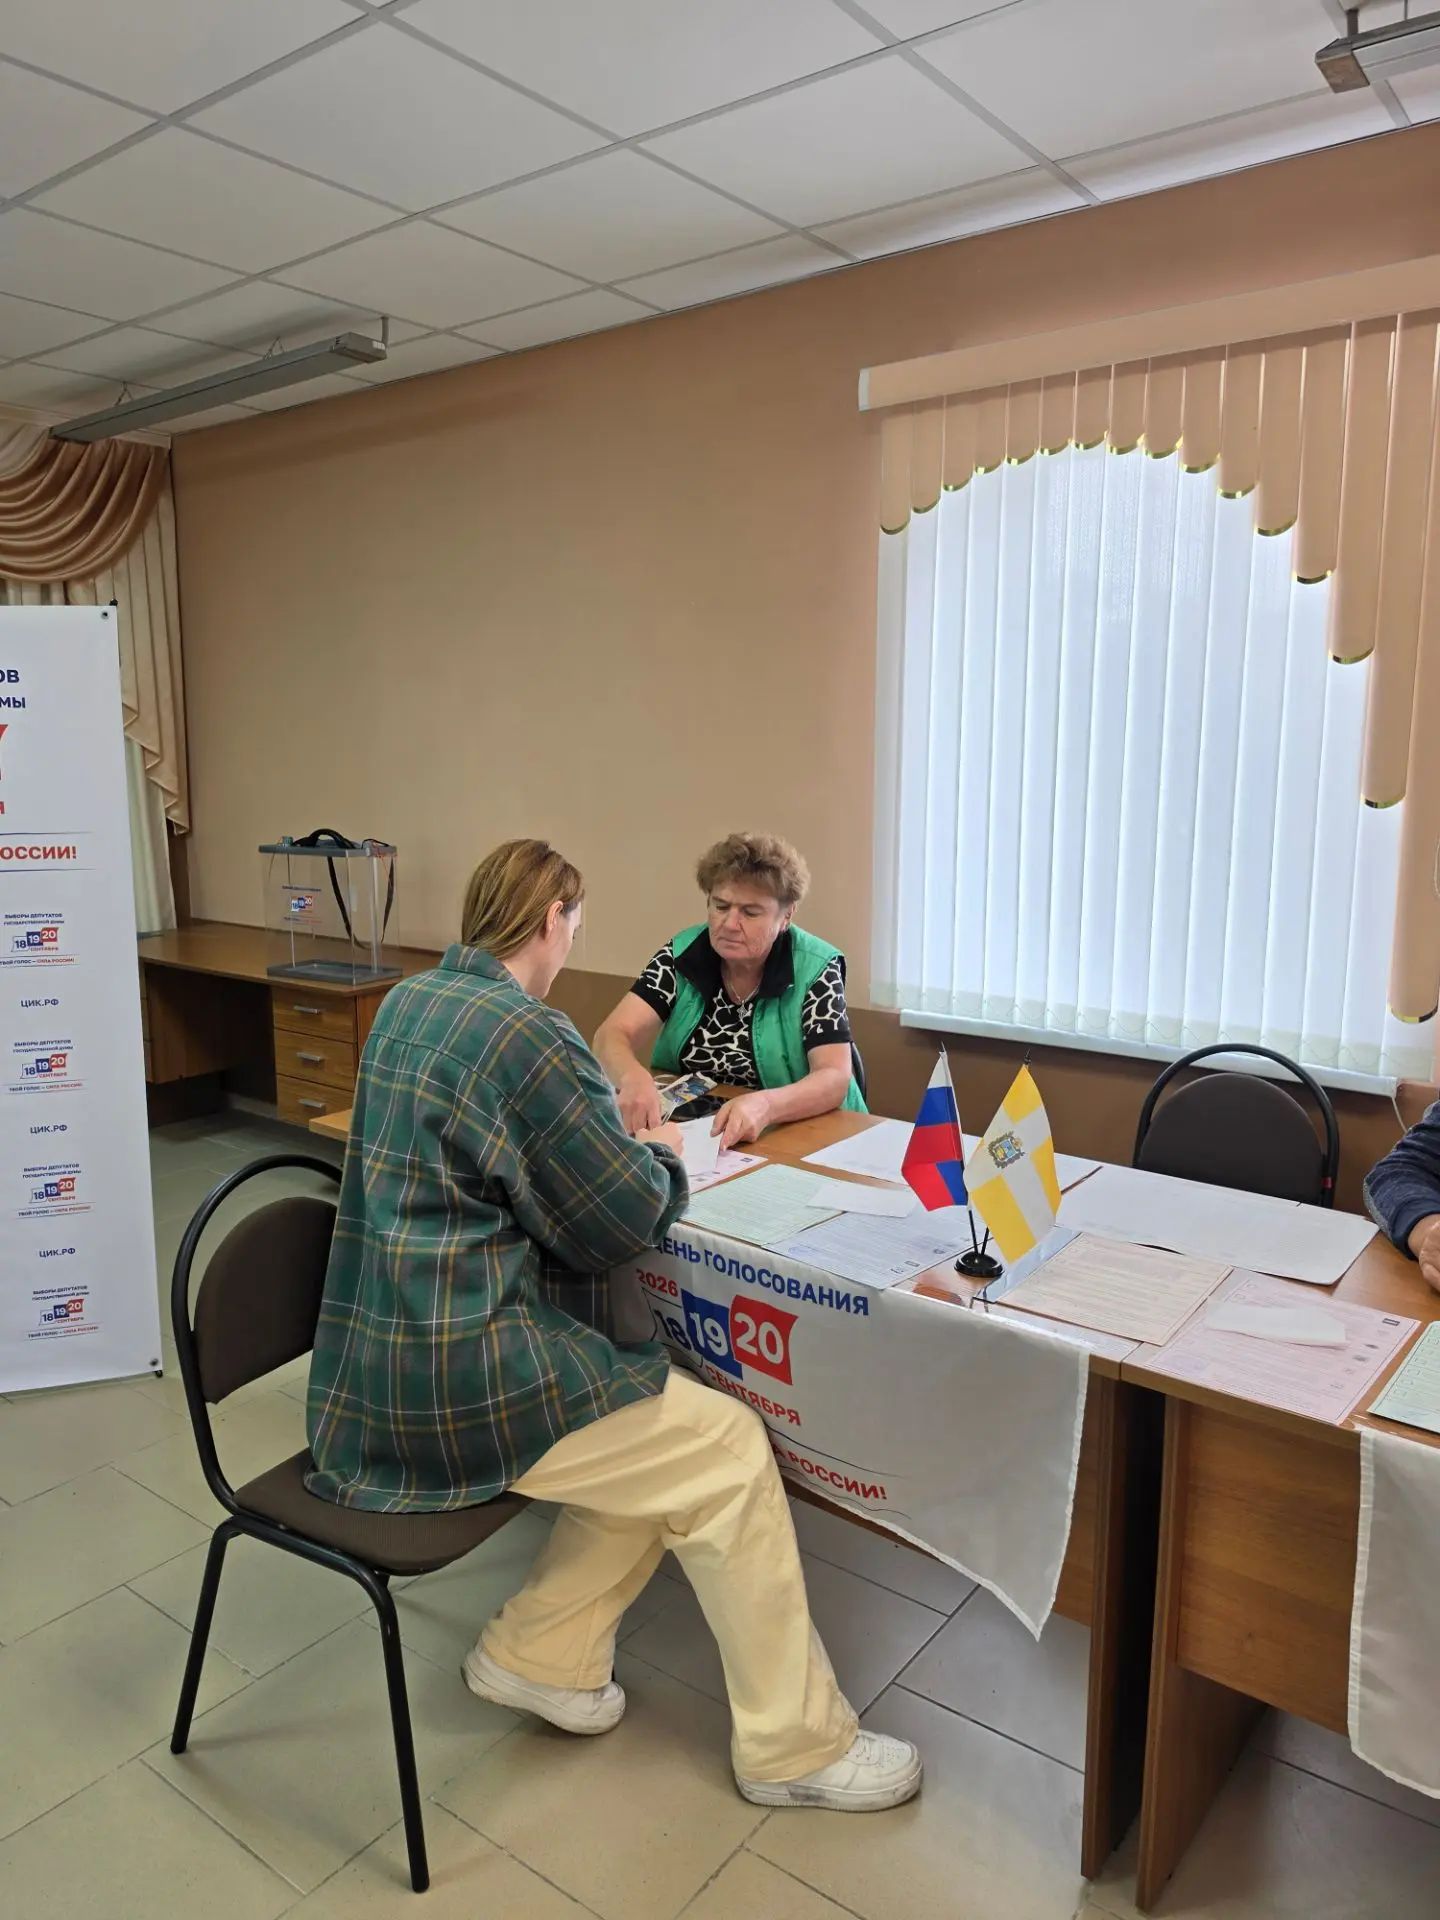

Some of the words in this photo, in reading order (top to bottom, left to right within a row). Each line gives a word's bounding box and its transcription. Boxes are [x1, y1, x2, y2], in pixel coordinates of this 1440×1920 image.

[0, 846, 76, 860] ОССИИ!
[15, 940, 26, 949] 18
[28, 935, 40, 944] 19
[42, 930, 56, 940] 20
[21, 998, 59, 1008] ЦИК.РФ
[24, 1067, 36, 1076] 18
[38, 1062, 48, 1070] 19
[51, 1057, 64, 1066] 20
[30, 1124, 68, 1134] ЦИК.РФ
[34, 1192, 44, 1200] 18
[59, 1181, 73, 1190] 20
[40, 1248, 76, 1258] ЦИК.РФ
[636, 1268, 678, 1297] 2026
[704, 1249, 868, 1316] ГОЛОСОВАНИЯ
[42, 1314, 54, 1322] 18
[68, 1302, 81, 1311] 20
[653, 1309, 692, 1350] 18
[689, 1312, 728, 1356] 19
[735, 1312, 783, 1364] 20
[705, 1364, 800, 1426] СЕНТЯБРЯ
[788, 1450, 887, 1500] РОССИИ!
